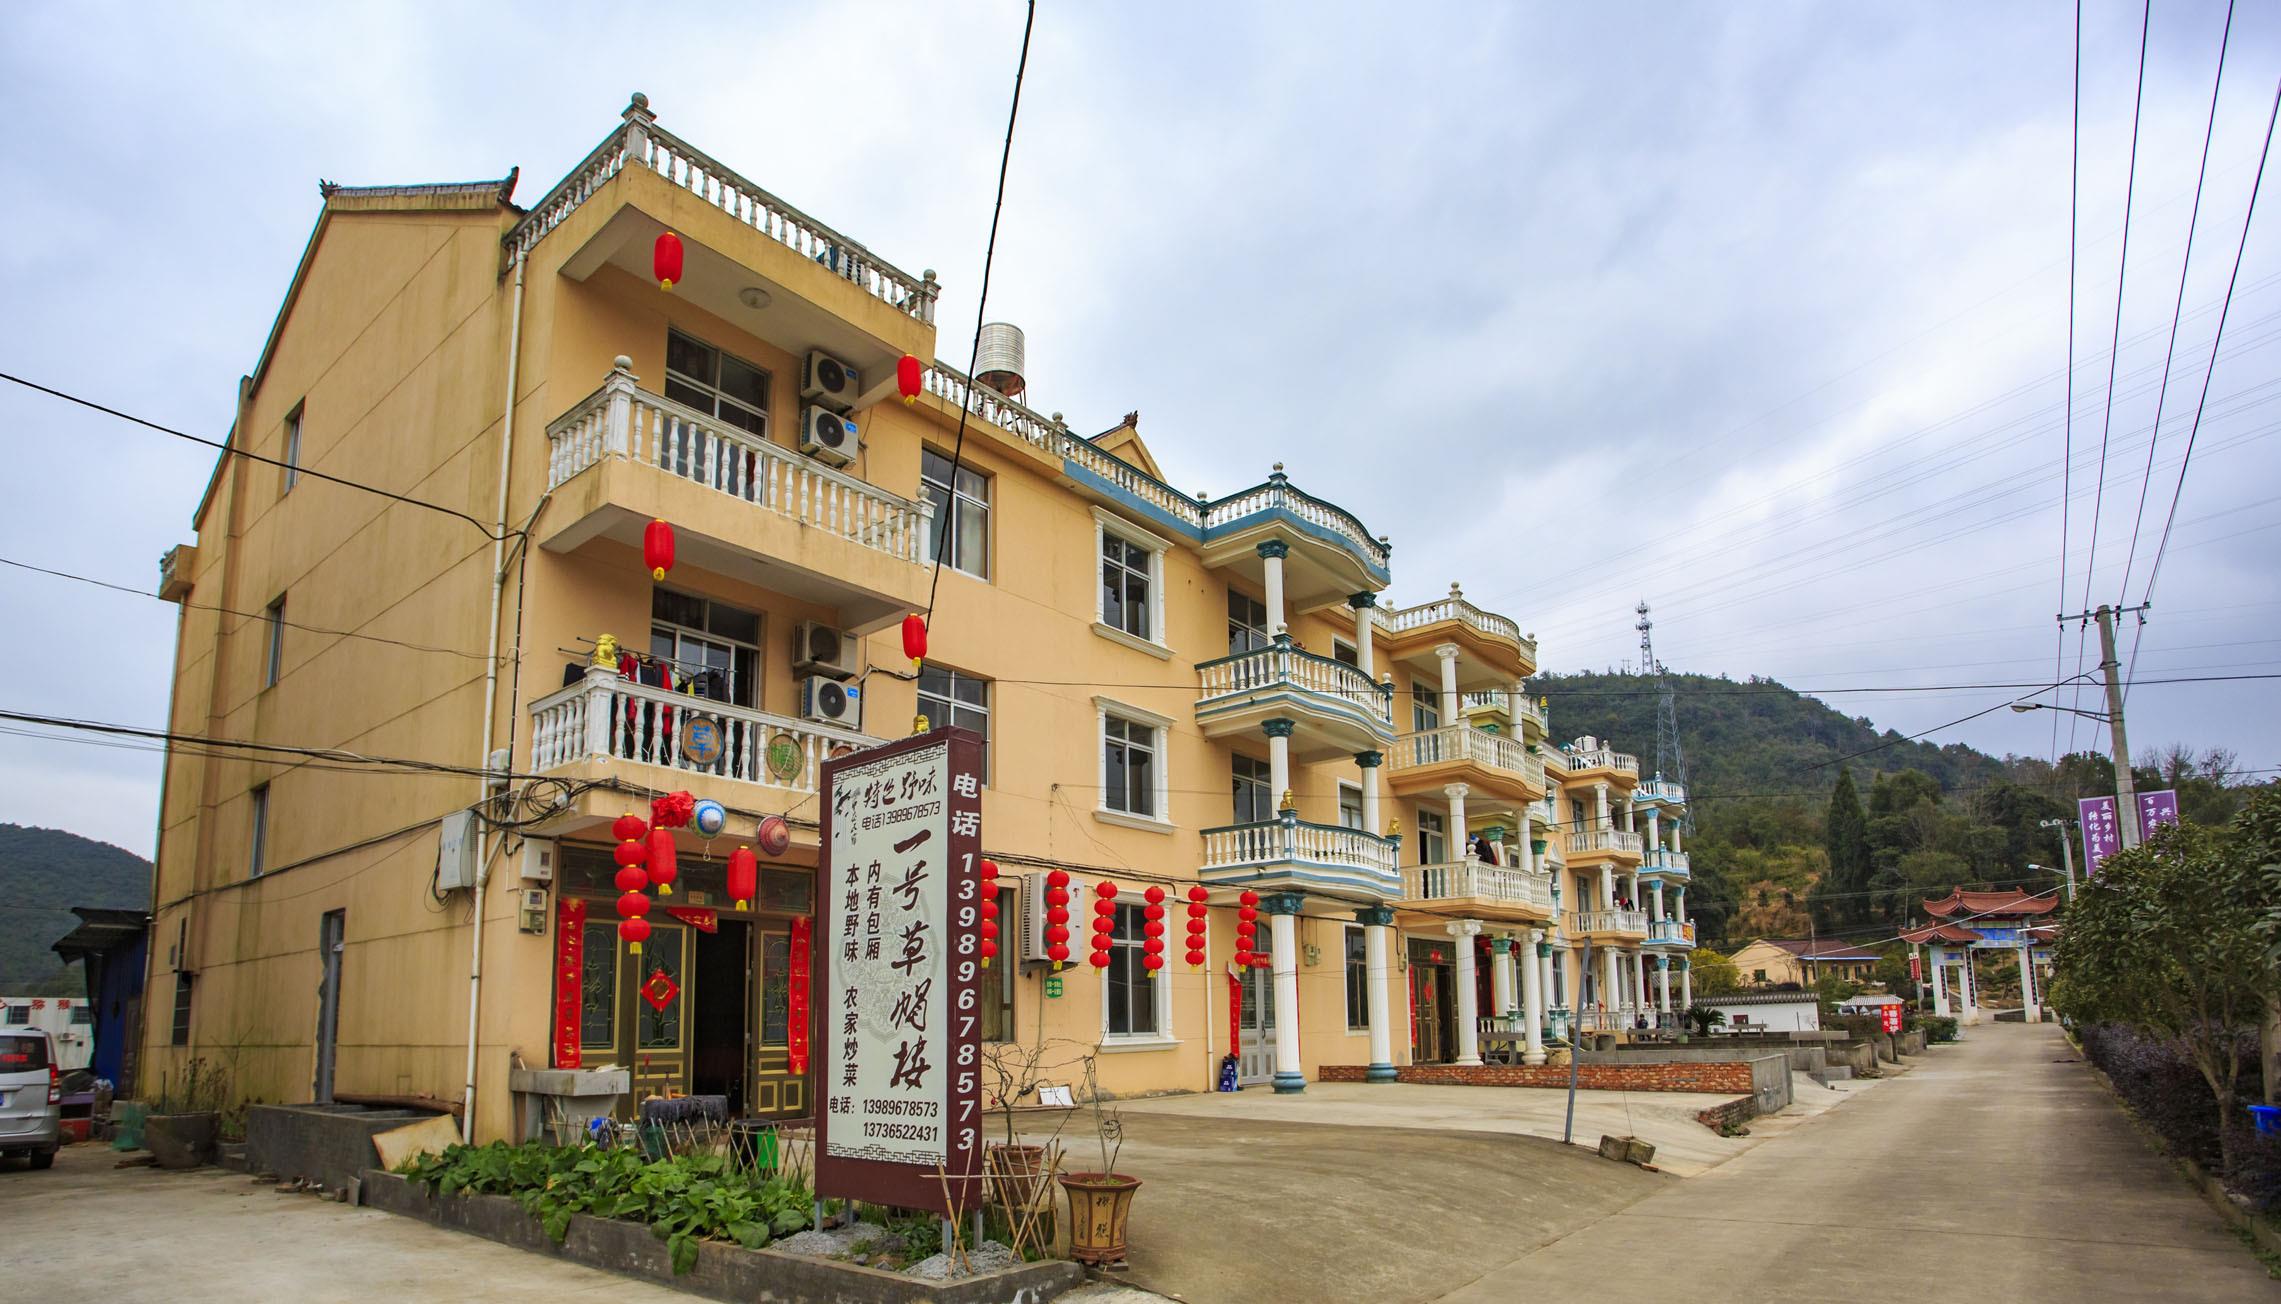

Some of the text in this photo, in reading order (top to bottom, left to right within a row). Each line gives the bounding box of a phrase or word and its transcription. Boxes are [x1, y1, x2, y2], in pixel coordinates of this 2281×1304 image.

[863, 766, 938, 810] 特色野味
[861, 801, 941, 831] 电话13989678573
[2100, 801, 2114, 843] 美丽乡村
[843, 863, 860, 963] 本地野味
[864, 859, 882, 961] 内有包厢
[952, 772, 981, 1151] 电话13989678573
[842, 986, 859, 1088] 农家炒菜
[863, 1098, 939, 1118] 13989678573
[863, 1121, 939, 1143] 13736522431
